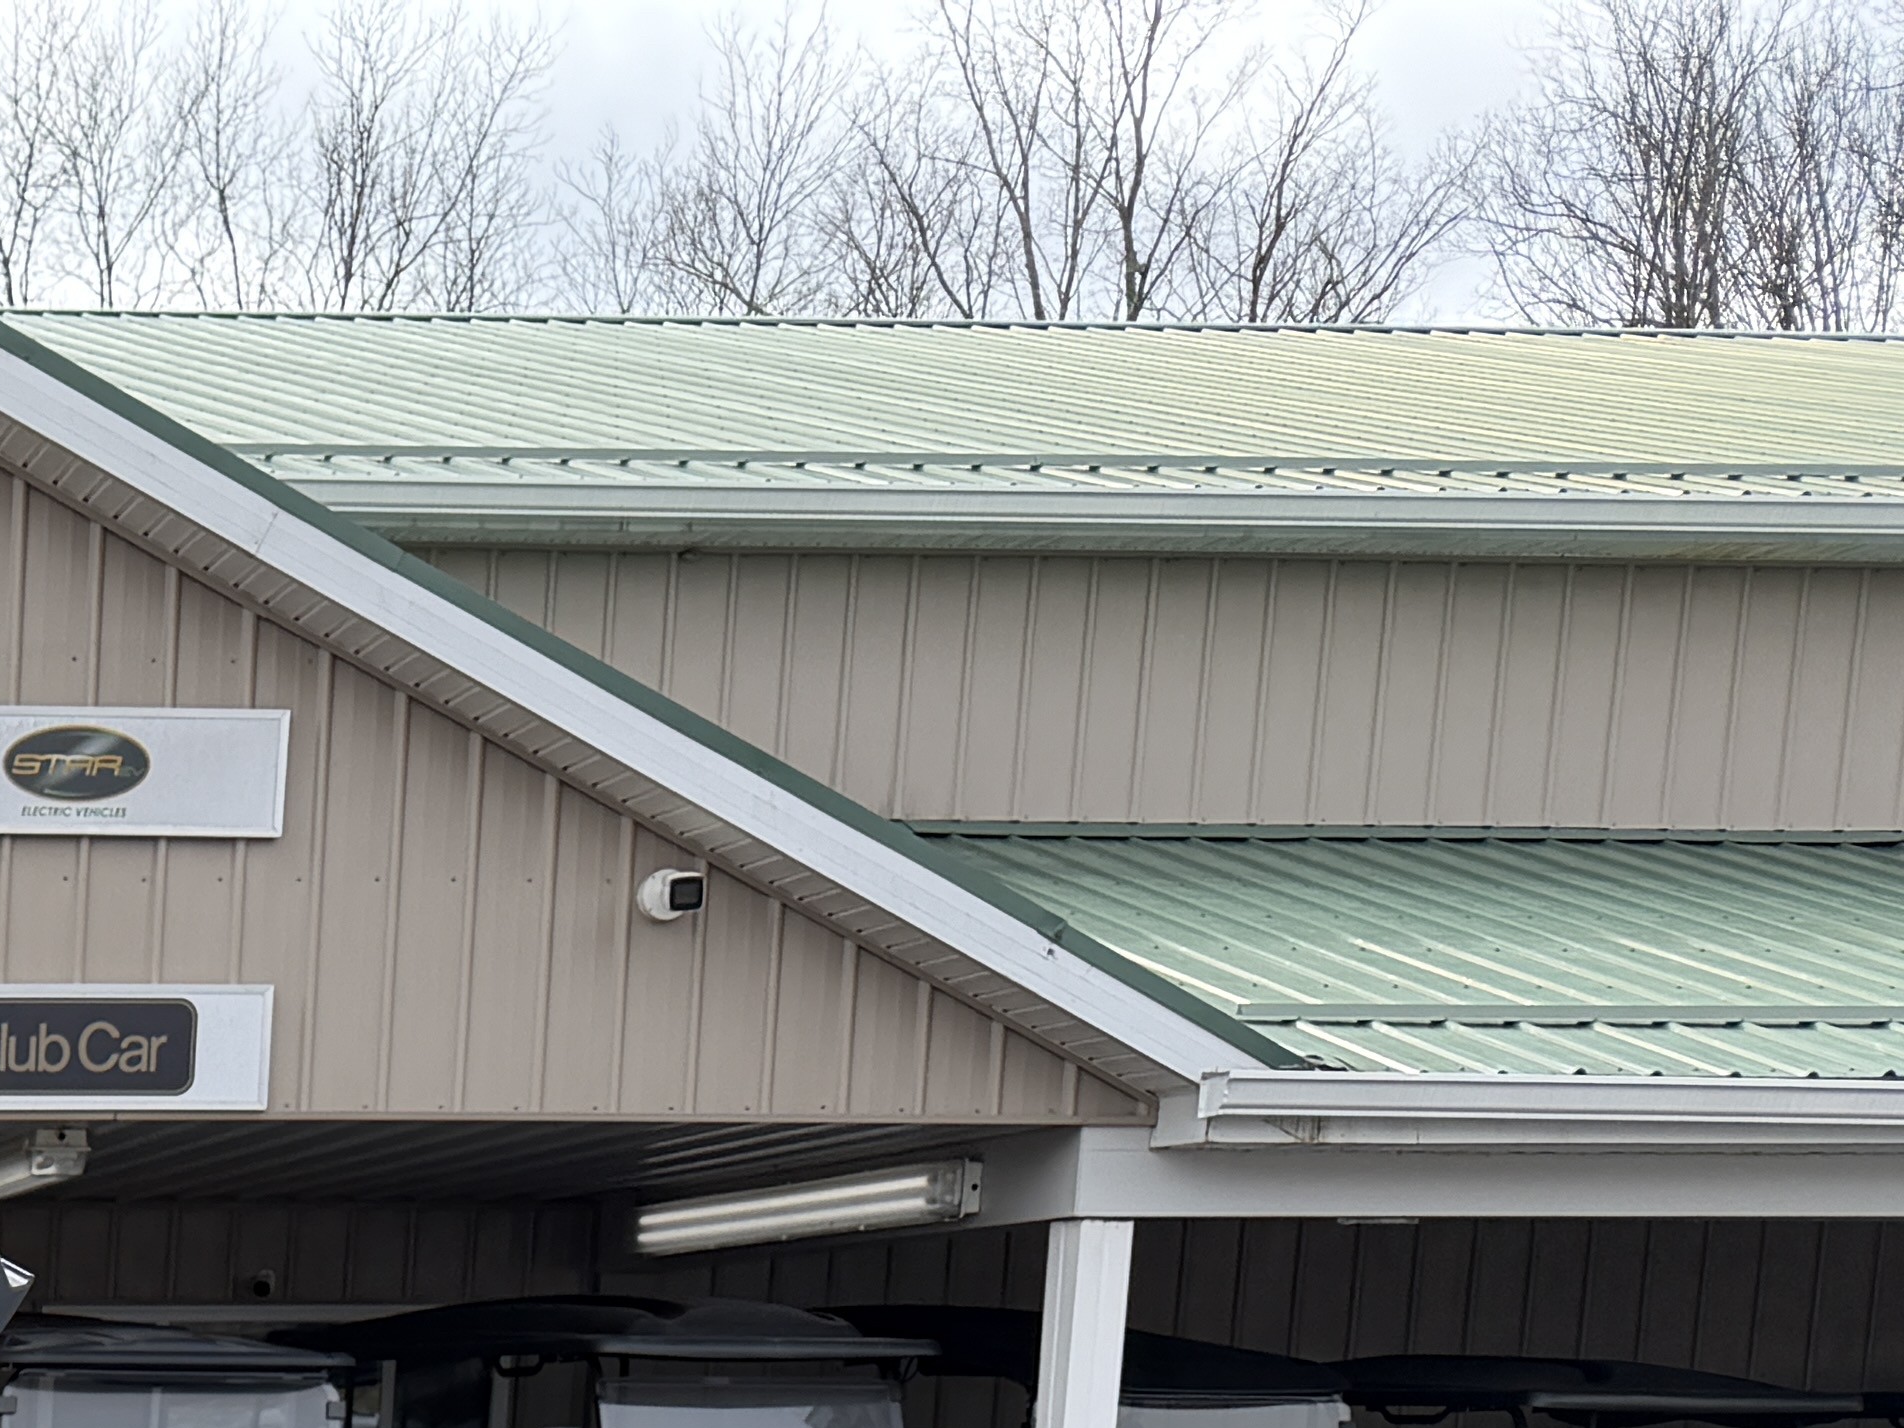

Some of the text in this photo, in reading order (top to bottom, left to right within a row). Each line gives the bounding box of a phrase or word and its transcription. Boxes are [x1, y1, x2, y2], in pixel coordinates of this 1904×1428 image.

[11, 753, 123, 777] STAR
[21, 805, 127, 818] ELECTRIC VEHICLES
[77, 1020, 168, 1074] Car
